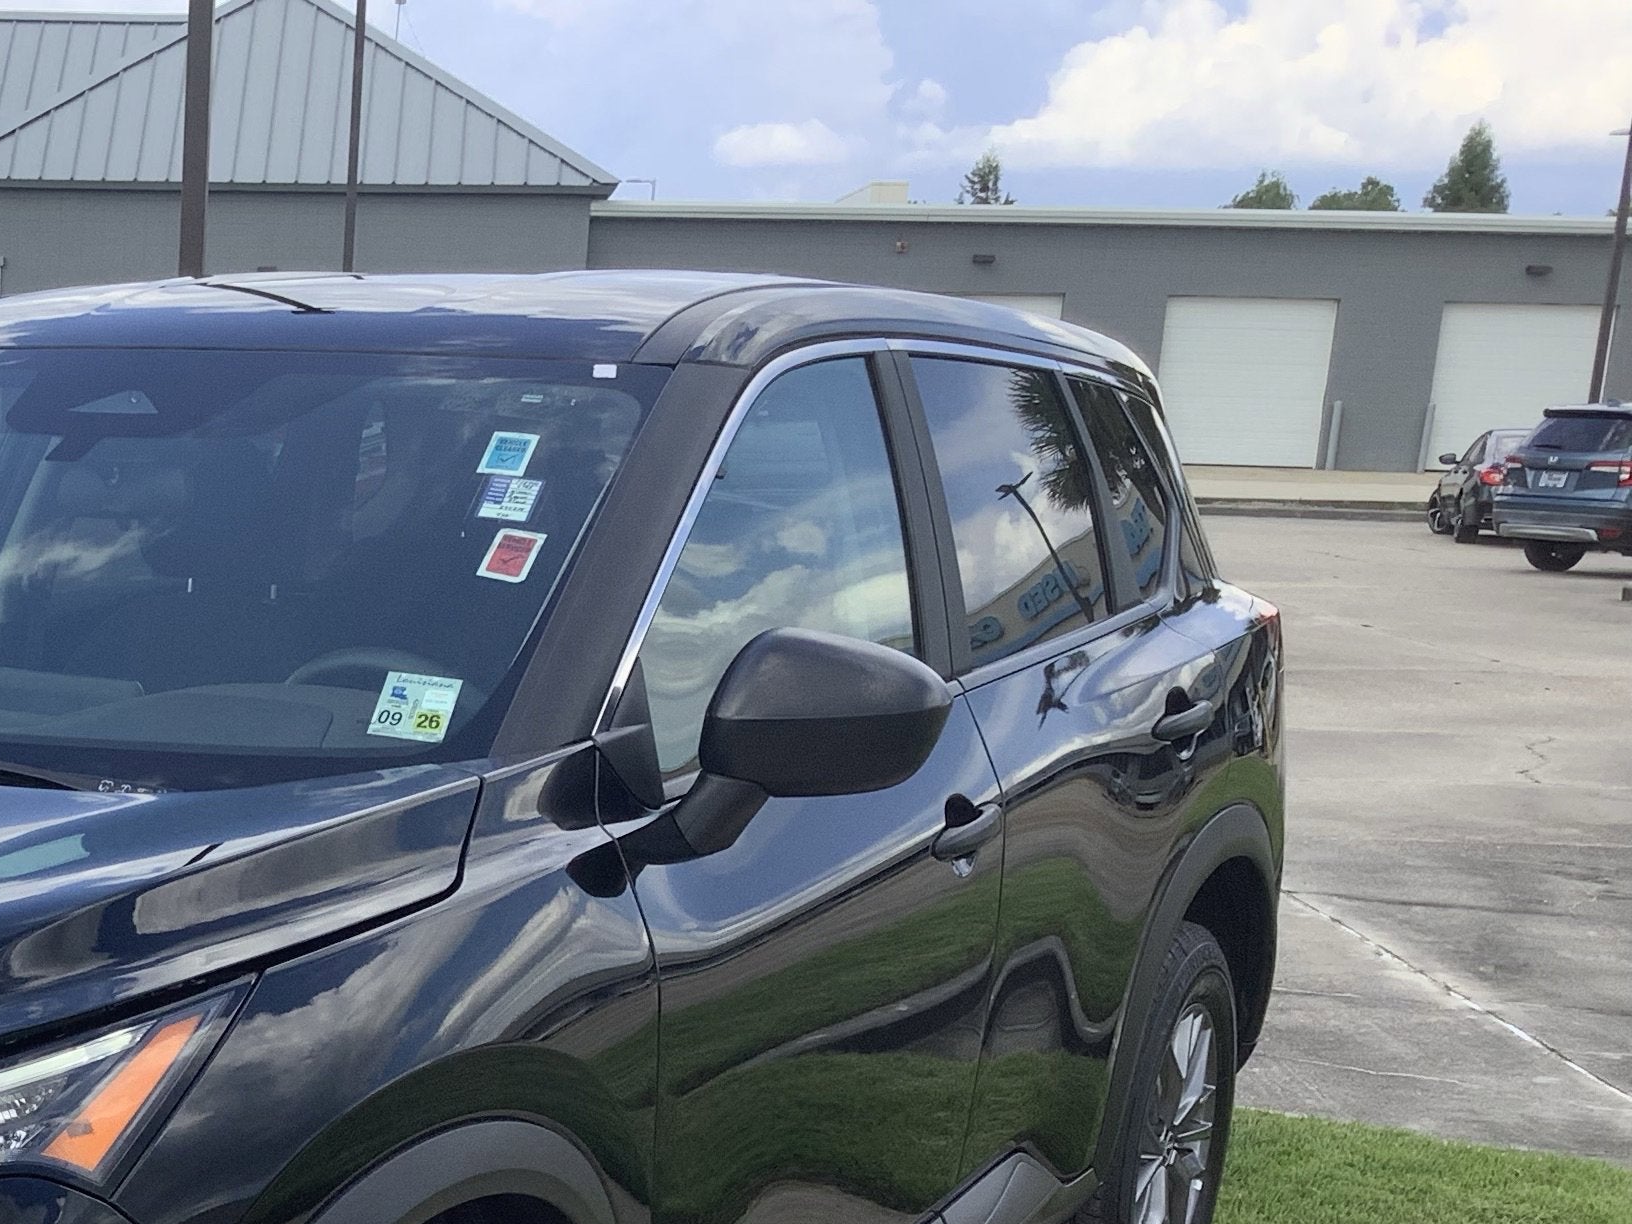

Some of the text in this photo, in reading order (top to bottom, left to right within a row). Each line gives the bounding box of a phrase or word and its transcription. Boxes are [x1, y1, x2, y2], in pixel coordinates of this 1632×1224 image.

[397, 674, 454, 689] Louisiana
[378, 709, 403, 726] 09
[416, 713, 441, 730] 26
